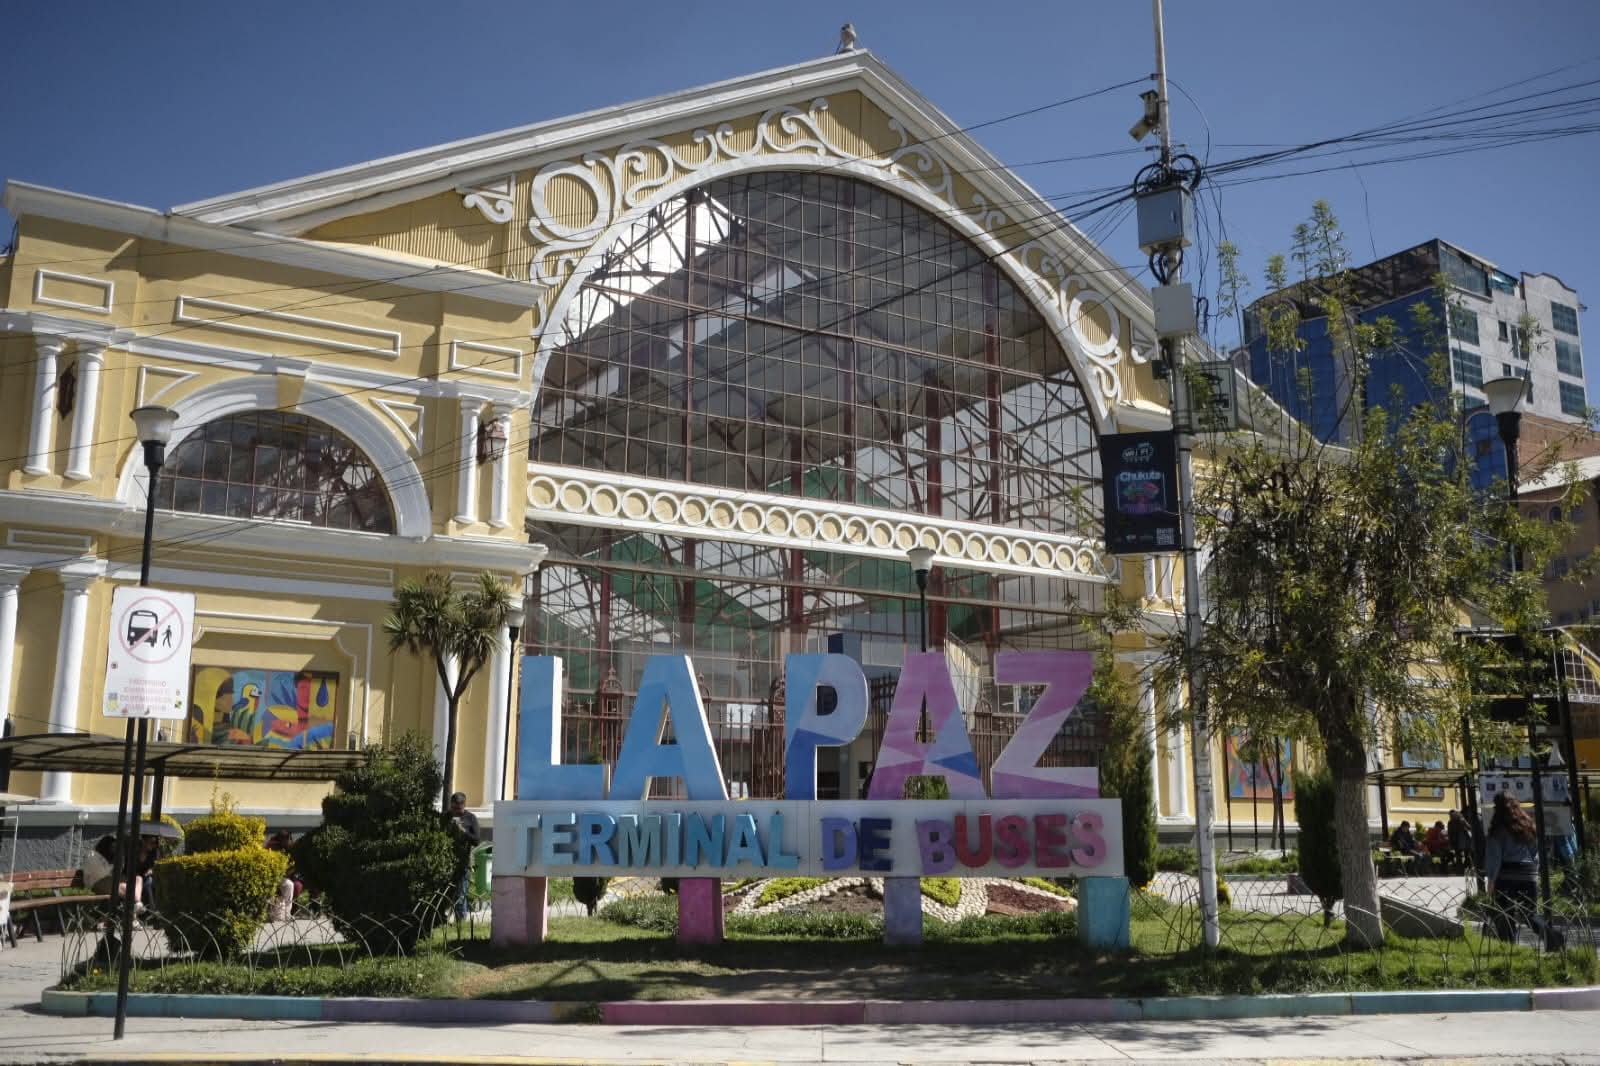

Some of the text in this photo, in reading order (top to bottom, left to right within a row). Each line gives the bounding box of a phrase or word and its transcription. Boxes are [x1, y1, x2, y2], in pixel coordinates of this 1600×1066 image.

[518, 651, 1099, 800] LA PAZ
[503, 811, 1107, 874] TERMINAL DE BUSES
